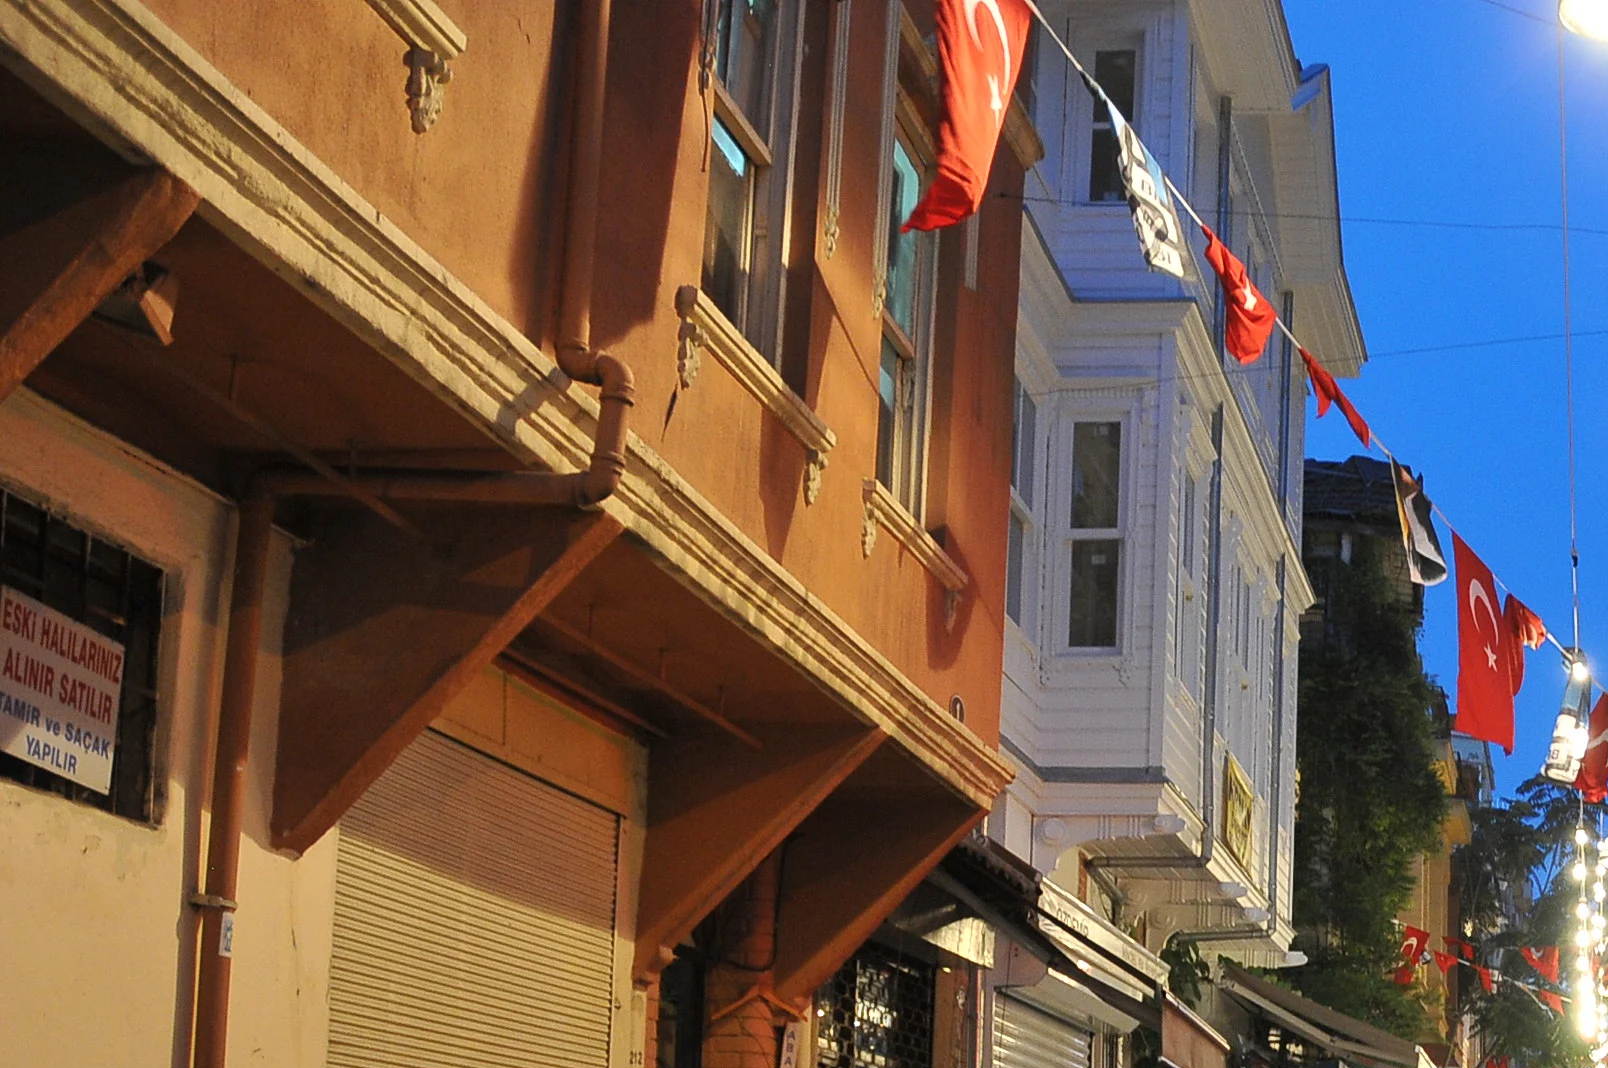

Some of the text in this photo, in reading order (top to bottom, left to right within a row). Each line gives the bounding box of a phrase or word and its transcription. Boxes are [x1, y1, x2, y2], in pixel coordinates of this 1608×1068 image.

[2, 598, 123, 684] ESKİ HALILARINIZ
[2, 647, 114, 725] ALINIR SATILIR
[25, 734, 78, 775] YAPILIR
[45, 716, 62, 736] ve
[65, 723, 111, 760] SAÇAK
